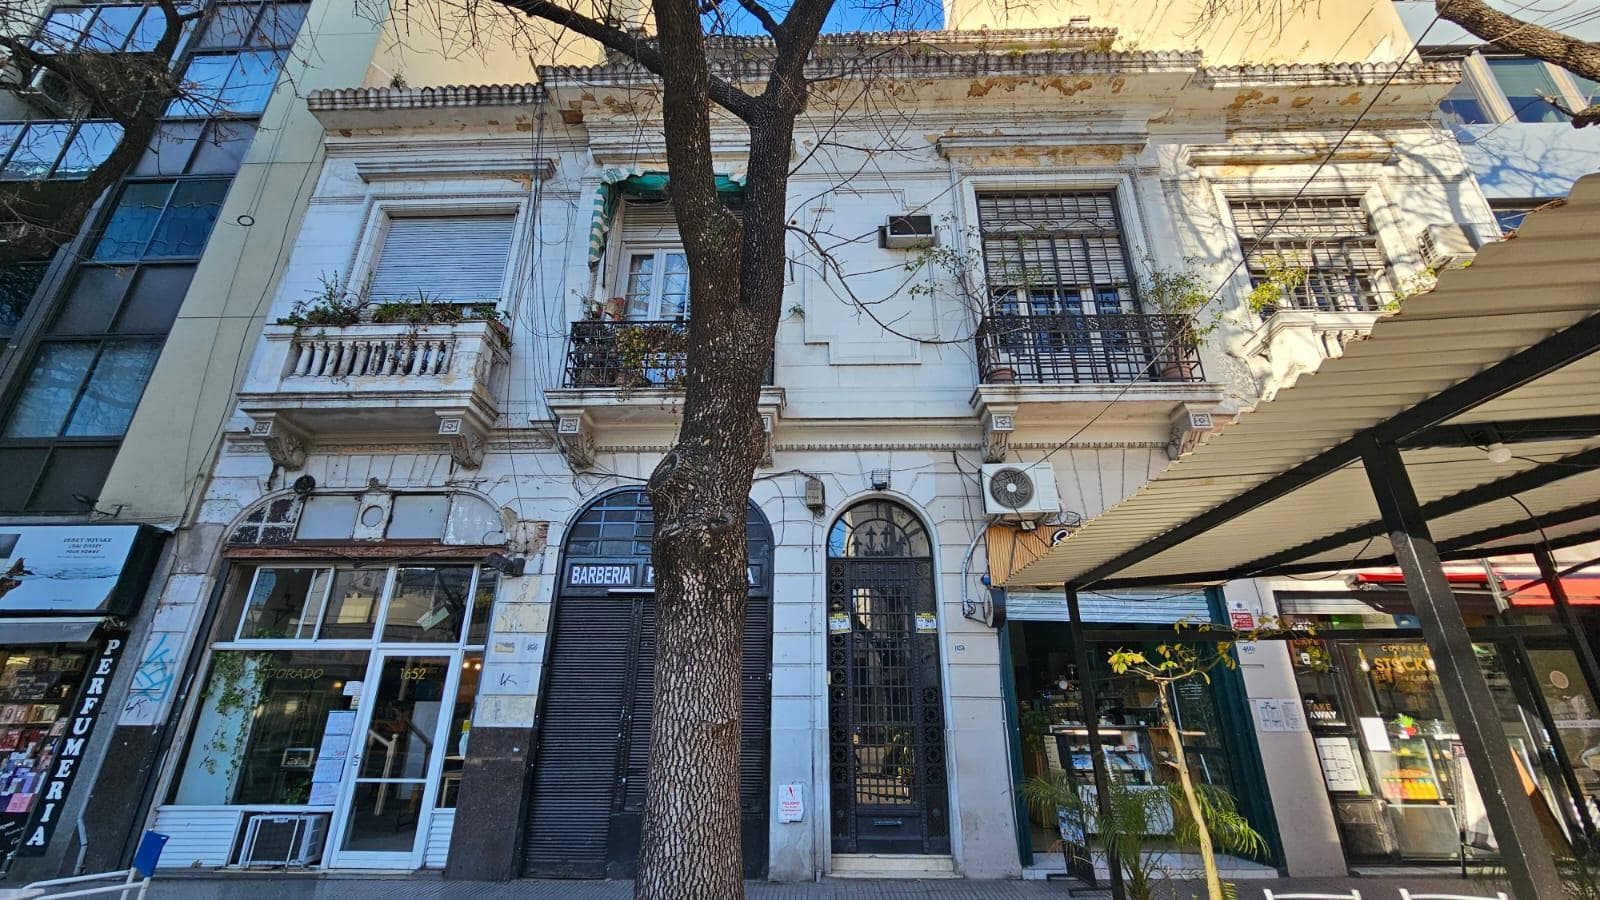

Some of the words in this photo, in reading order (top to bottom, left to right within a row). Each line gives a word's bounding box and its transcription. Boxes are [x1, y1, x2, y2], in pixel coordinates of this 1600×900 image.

[571, 566, 631, 584] BARBERIA
[267, 668, 324, 679] DORADO
[400, 667, 426, 680] 1652
[1307, 703, 1332, 711] TAKE
[1309, 711, 1337, 719] AWAY
[26, 639, 121, 846] PERFUMERIA
